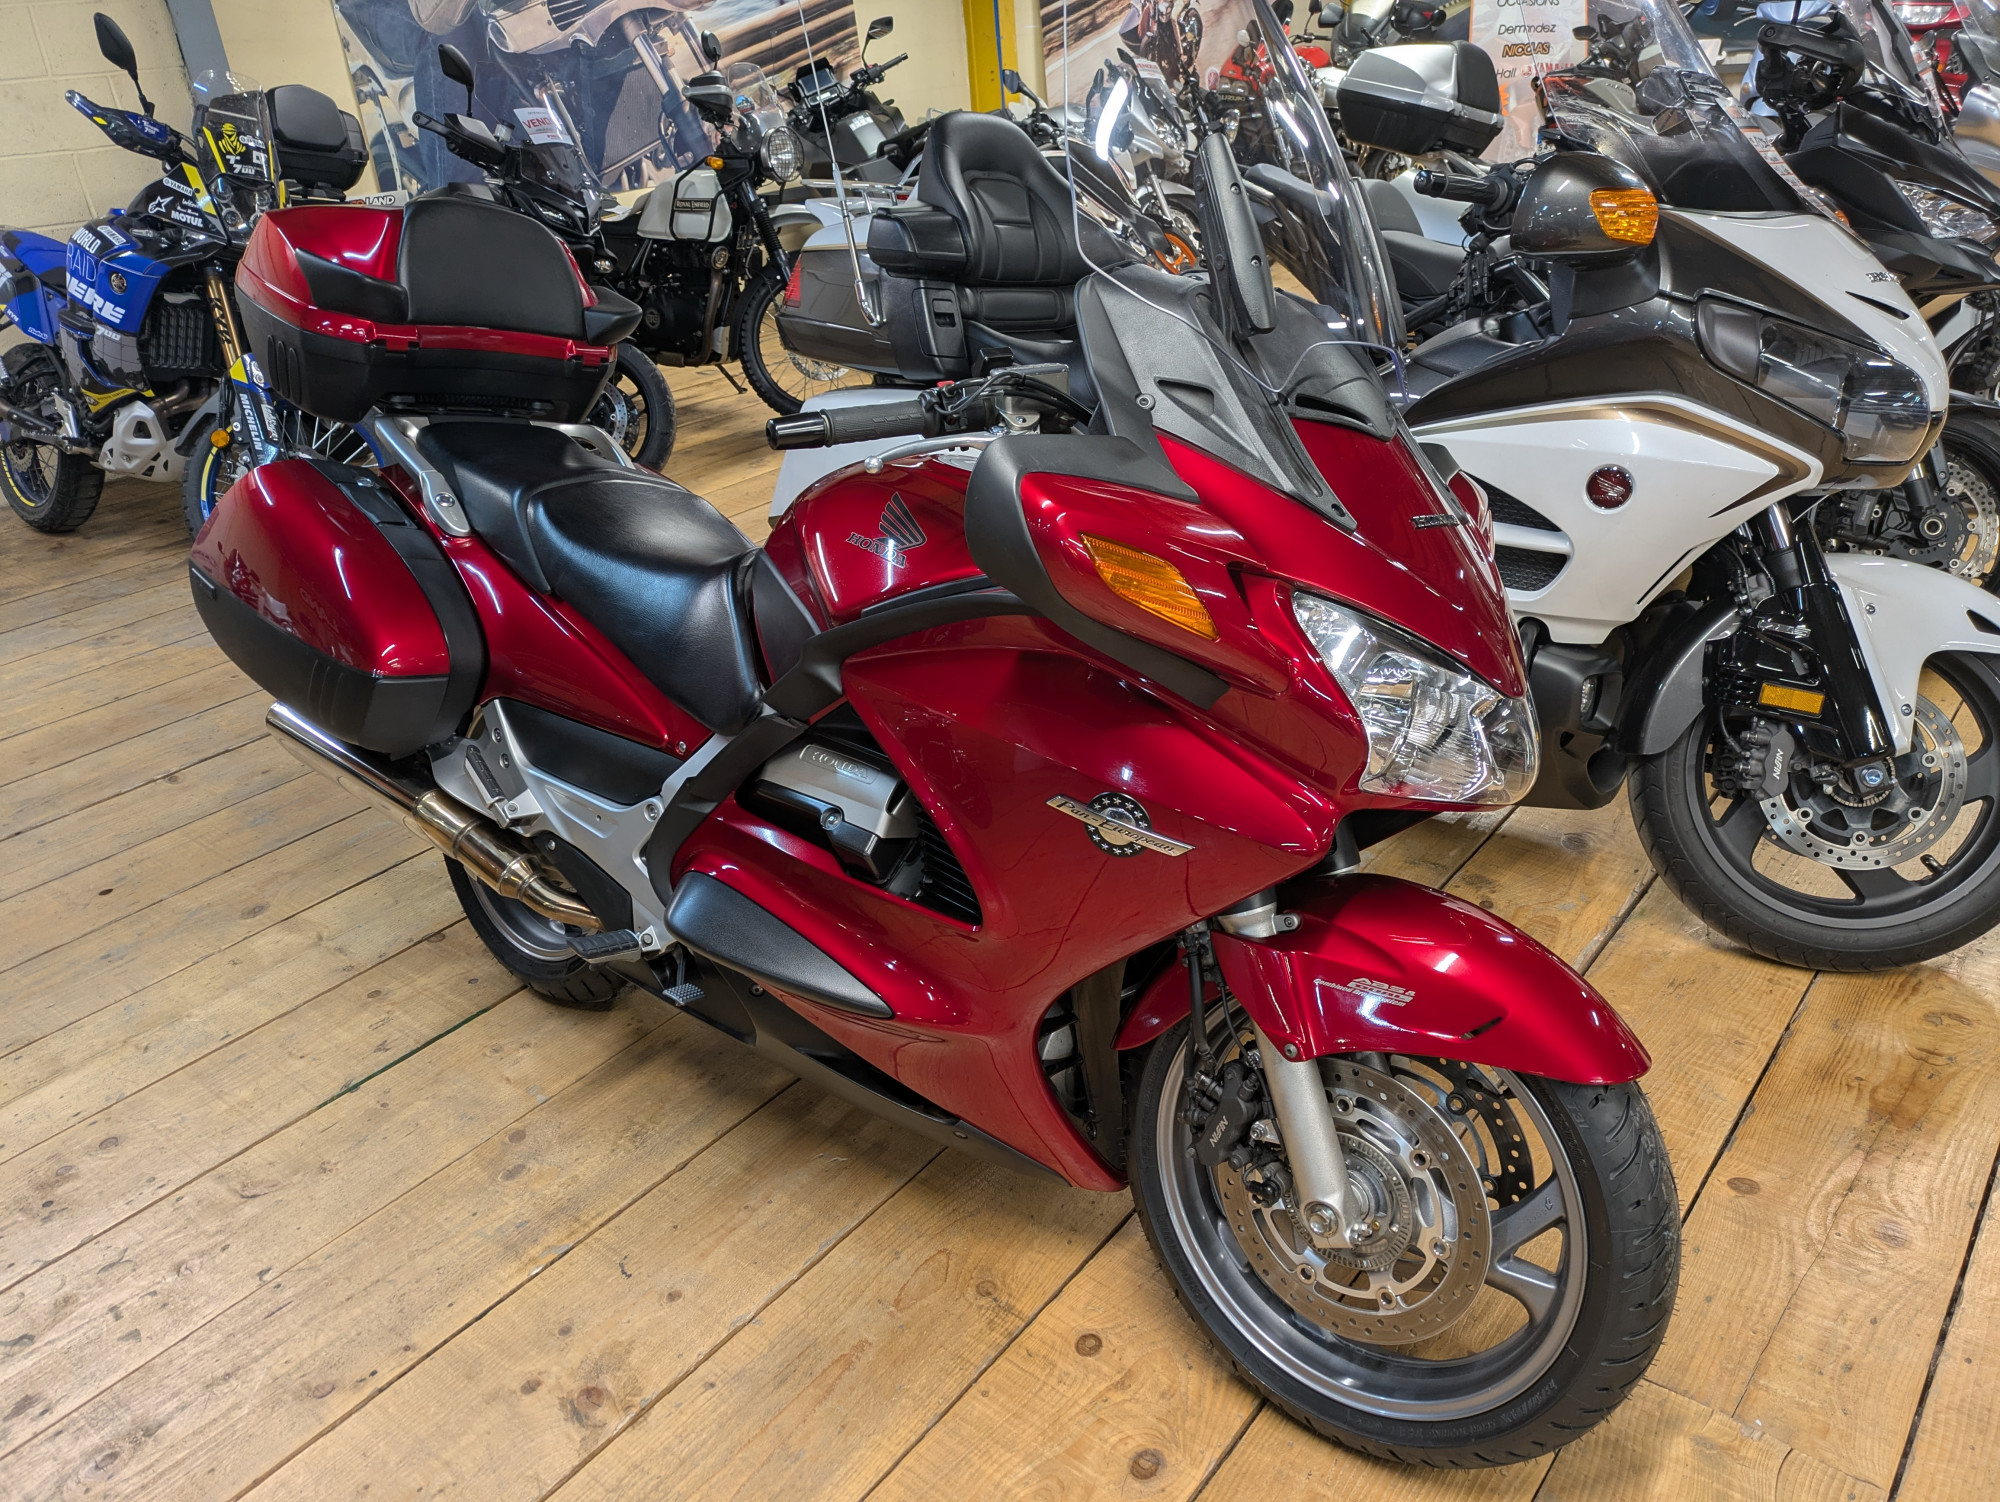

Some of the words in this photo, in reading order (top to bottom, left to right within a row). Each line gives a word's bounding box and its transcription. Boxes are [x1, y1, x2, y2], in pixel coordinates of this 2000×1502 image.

[1496, 67, 1517, 79] Hall
[169, 180, 194, 197] YAMAHA
[676, 200, 691, 208] ROYAL
[170, 210, 204, 228] MOTUL
[71, 227, 102, 254] WORLD
[66, 241, 97, 282] RAID
[239, 393, 264, 451] MICHELIN
[845, 531, 907, 569] HONDA
[812, 750, 868, 780] HONDA
[1313, 978, 1353, 994] Combined
